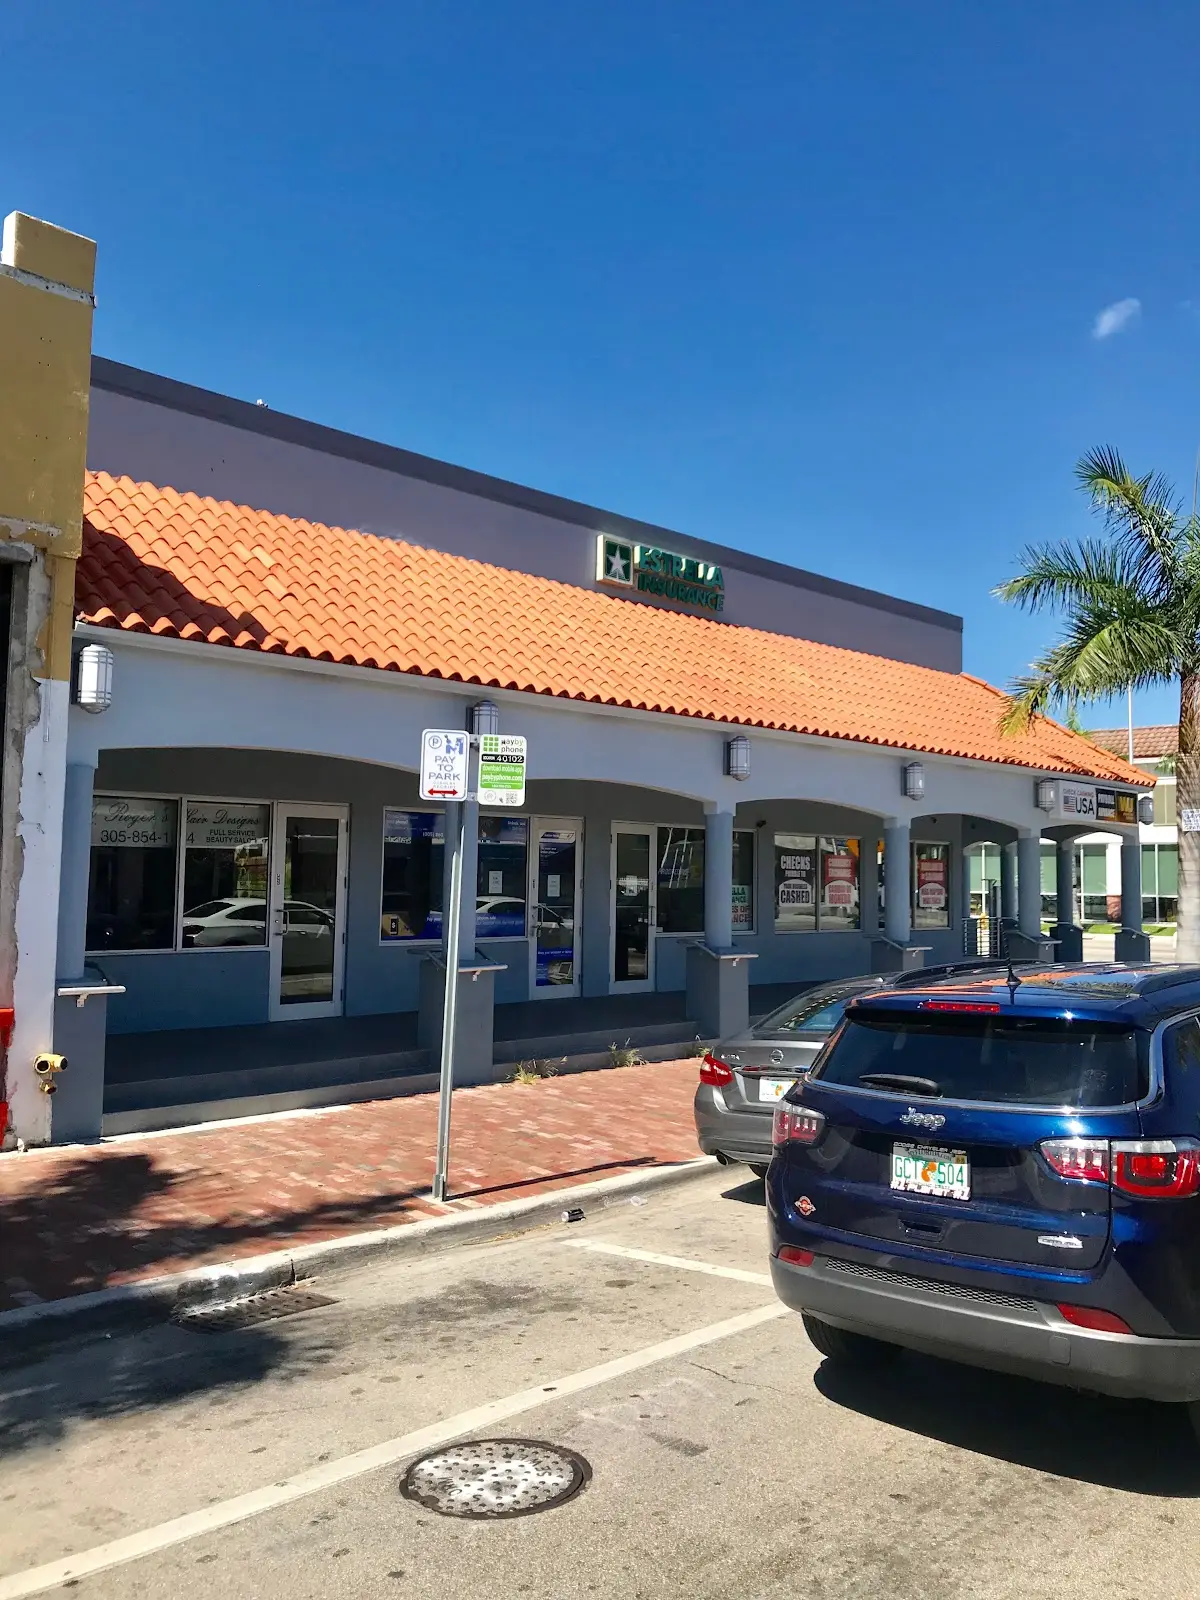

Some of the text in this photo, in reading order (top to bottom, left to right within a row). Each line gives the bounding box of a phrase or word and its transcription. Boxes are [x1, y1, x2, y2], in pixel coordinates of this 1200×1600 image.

[634, 545, 724, 590] ESTRELLA
[637, 573, 725, 611] INSURANCE
[434, 755, 456, 763] PAY
[437, 763, 453, 772] TO
[428, 772, 460, 781] PARK
[1075, 796, 1095, 815] USA
[209, 828, 226, 836] FULL
[780, 855, 811, 870] CHECKS
[780, 890, 810, 904] CASHED
[899, 1106, 946, 1131] Jeep
